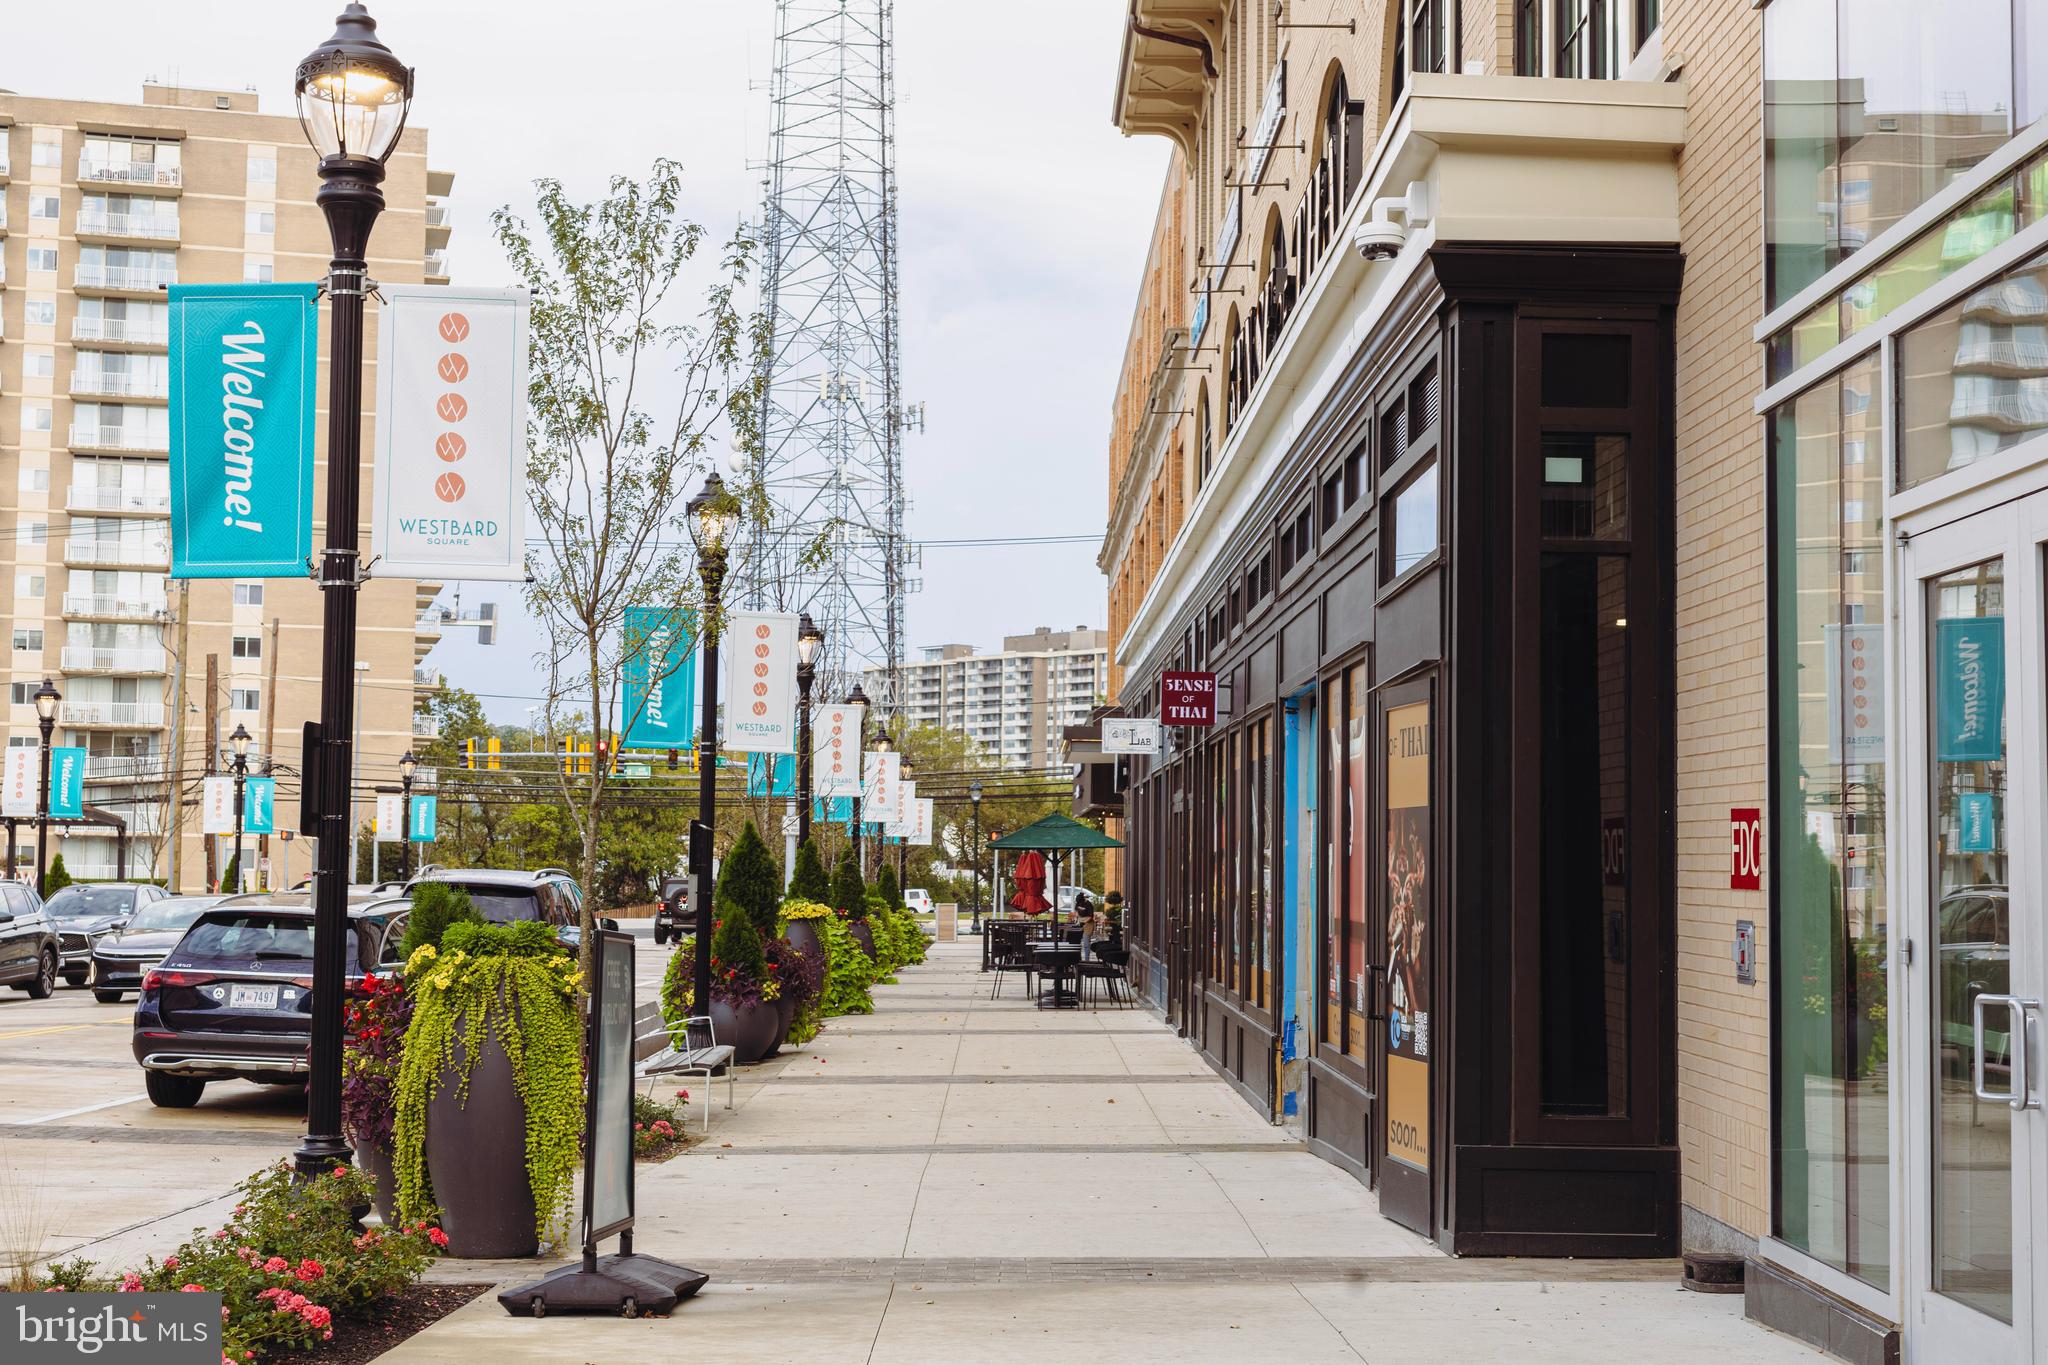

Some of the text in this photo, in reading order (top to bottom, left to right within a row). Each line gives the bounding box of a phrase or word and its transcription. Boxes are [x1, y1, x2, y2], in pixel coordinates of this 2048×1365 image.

[222, 320, 265, 533] Welcome!
[399, 518, 498, 537] WESTBARD
[426, 537, 470, 546] SQUARE
[1181, 695, 1195, 703] OF
[1168, 706, 1208, 719] THAI
[735, 722, 782, 733] WESTBARD
[60, 755, 74, 808] Welcome!
[1731, 819, 1760, 877] FDC
[253, 991, 274, 1003] 7497
[1390, 1119, 1426, 1154] soon...
